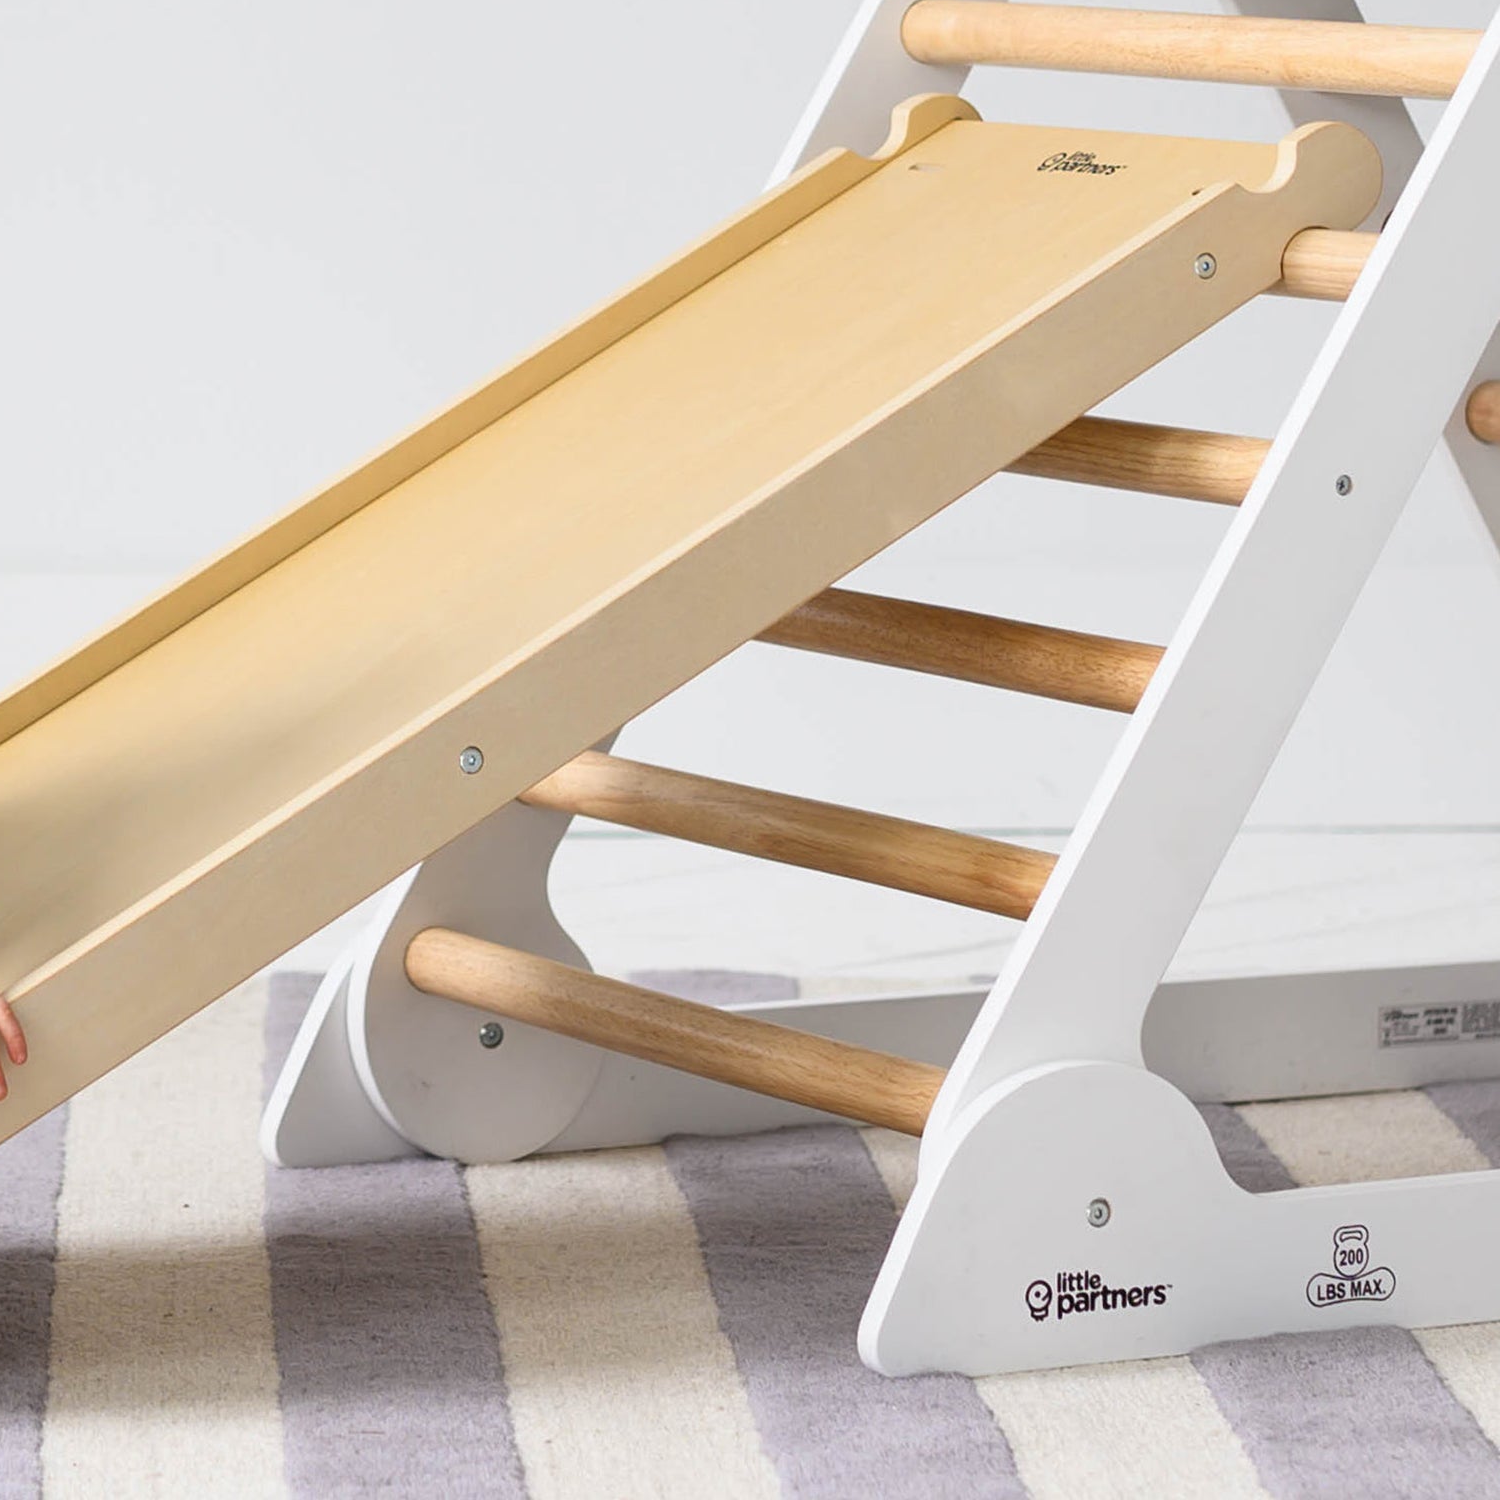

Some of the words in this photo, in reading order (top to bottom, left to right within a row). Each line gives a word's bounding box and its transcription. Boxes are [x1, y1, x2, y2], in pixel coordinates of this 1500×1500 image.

[1339, 1247, 1364, 1267] 200
[1057, 1269, 1102, 1293] little
[1317, 1283, 1346, 1301] LBS
